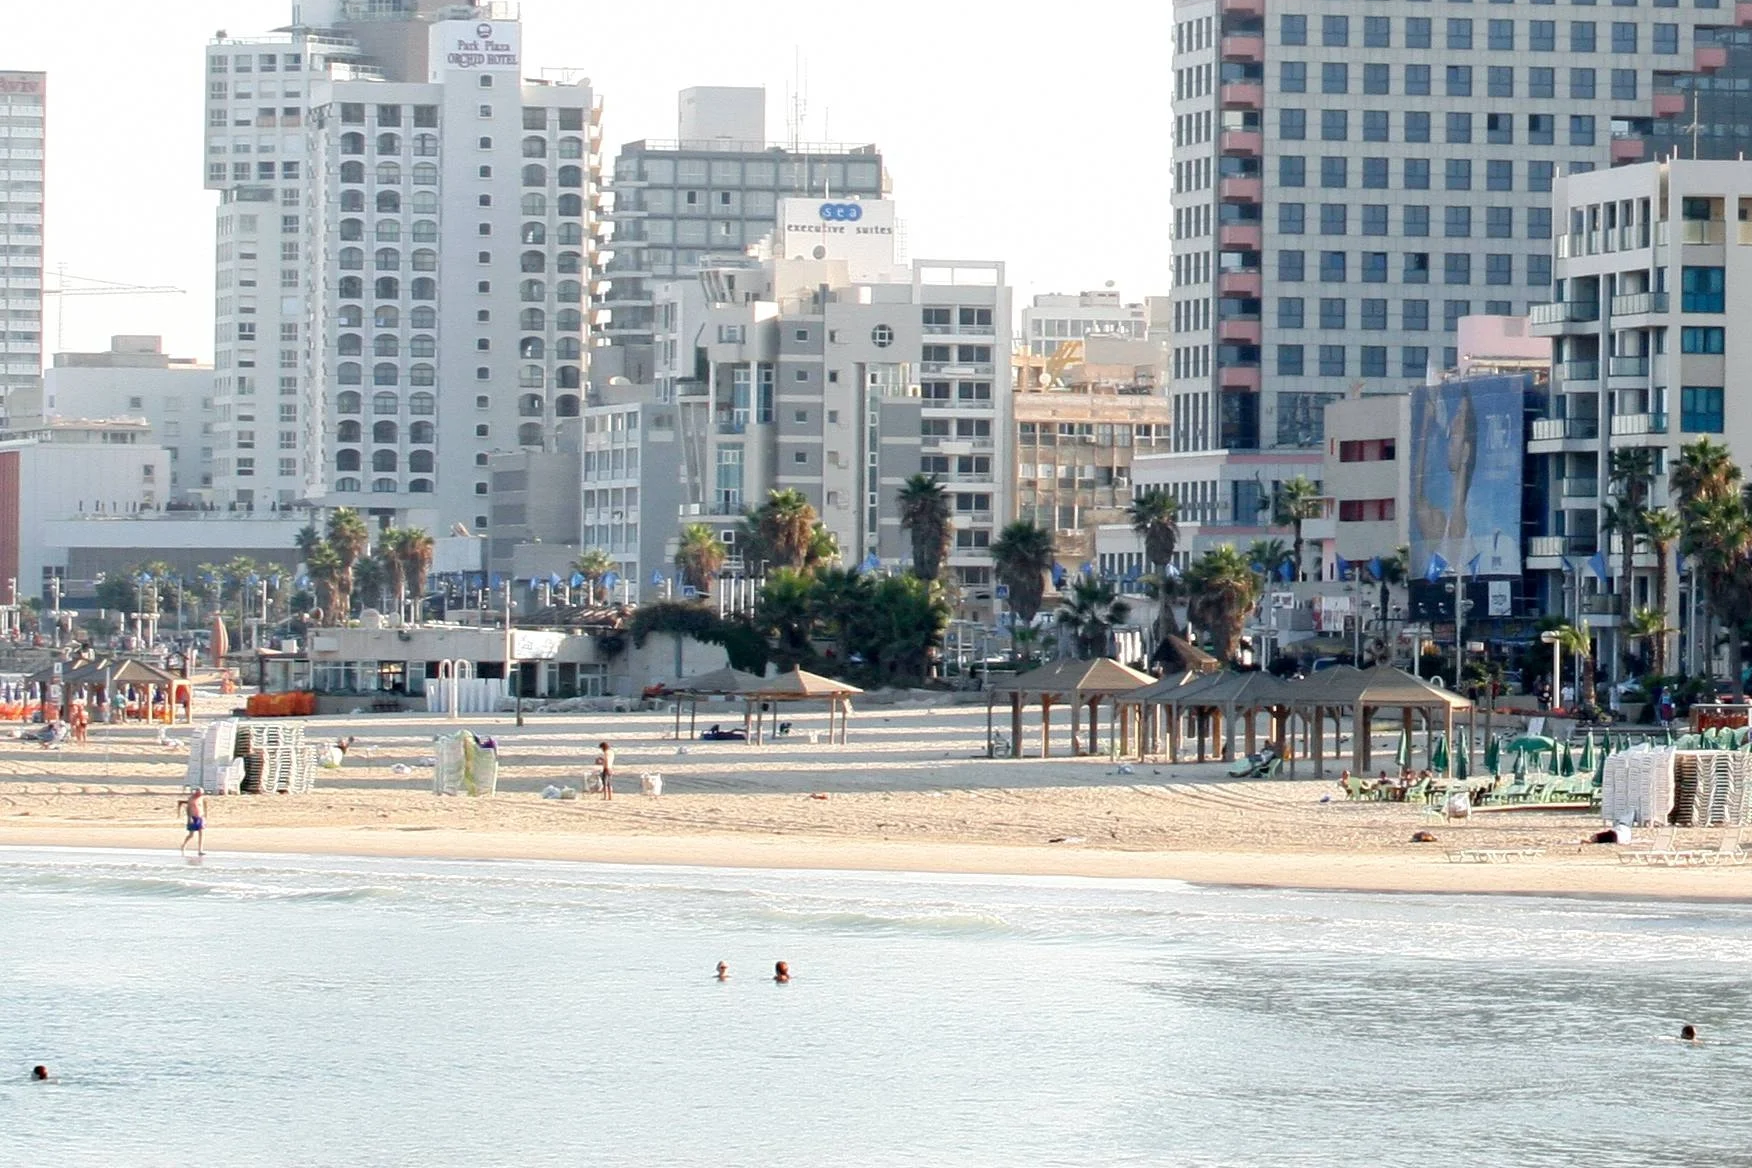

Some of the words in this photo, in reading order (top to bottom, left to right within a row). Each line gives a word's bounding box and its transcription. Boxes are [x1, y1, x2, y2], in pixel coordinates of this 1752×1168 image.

[457, 39, 480, 51] Park
[484, 40, 511, 51] Plaza
[447, 53, 485, 68] ORCHID
[487, 54, 518, 65] HOTEL
[822, 206, 857, 217] sea
[856, 224, 893, 235] suites
